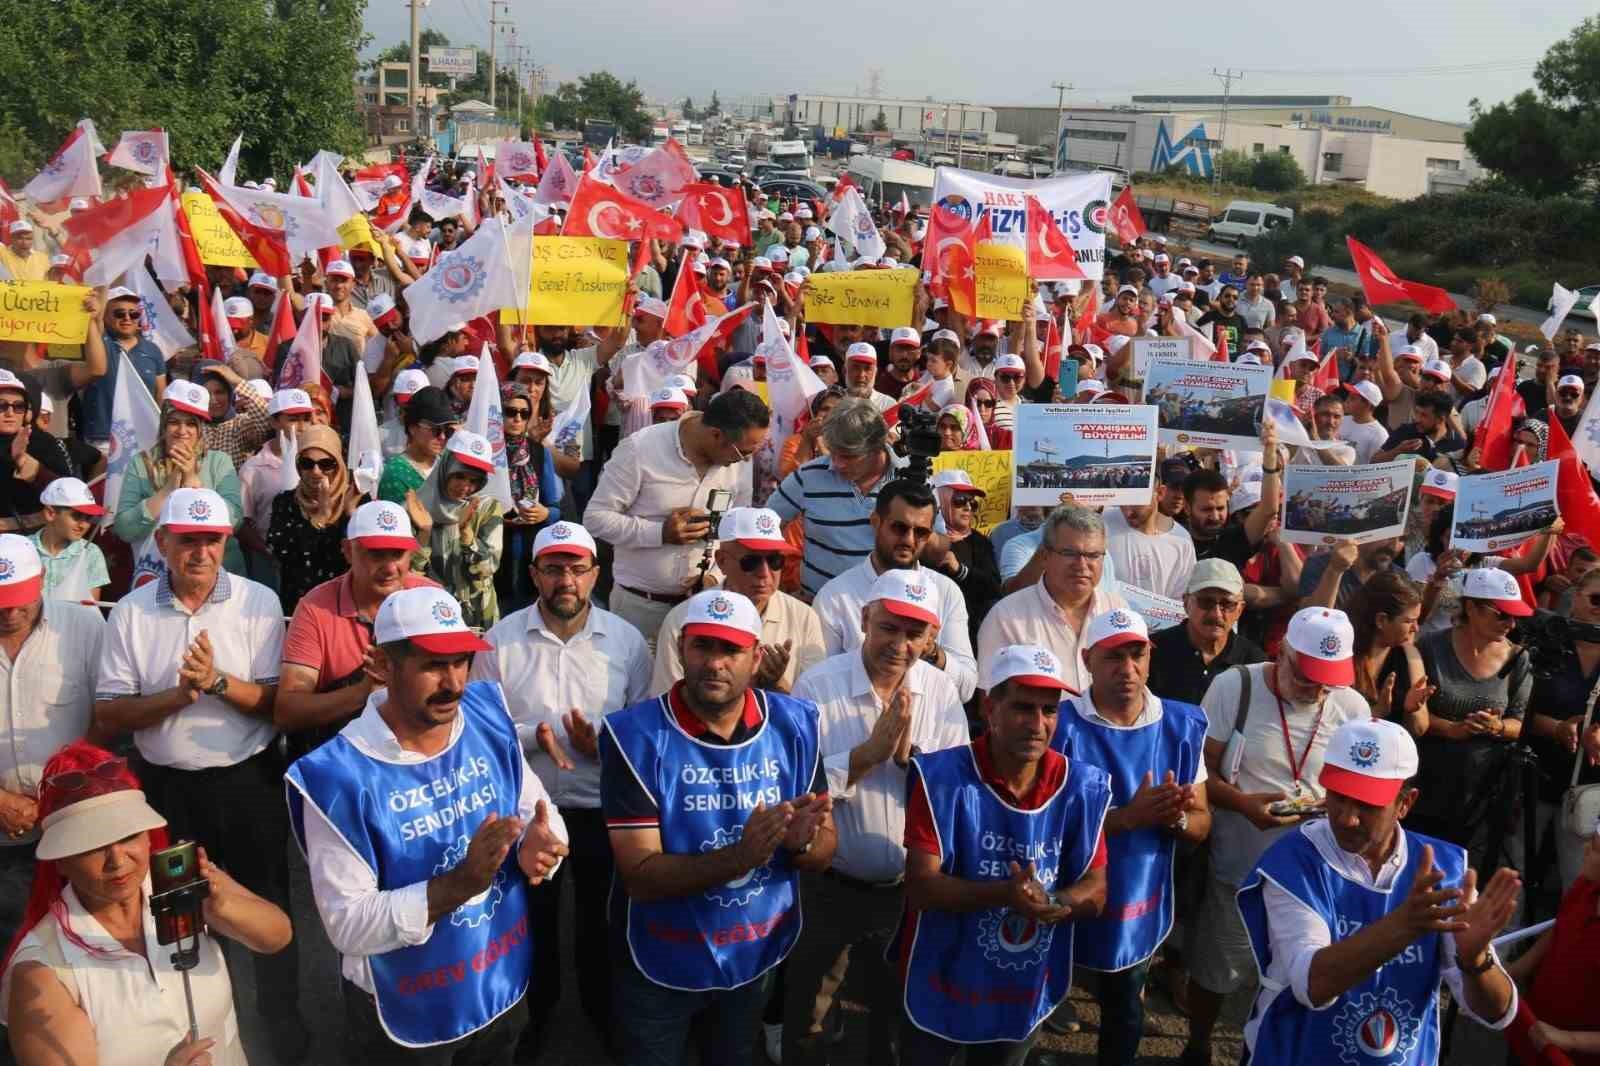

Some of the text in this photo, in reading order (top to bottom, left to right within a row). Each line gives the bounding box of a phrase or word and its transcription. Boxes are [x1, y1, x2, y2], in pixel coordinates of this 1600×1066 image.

[389, 756, 489, 813] ÖZÇELİK-İŞ
[681, 758, 780, 789] ÖZÇELİK-İŞ
[400, 784, 497, 841] SENDİKASI
[683, 786, 781, 811] SENDİKASI
